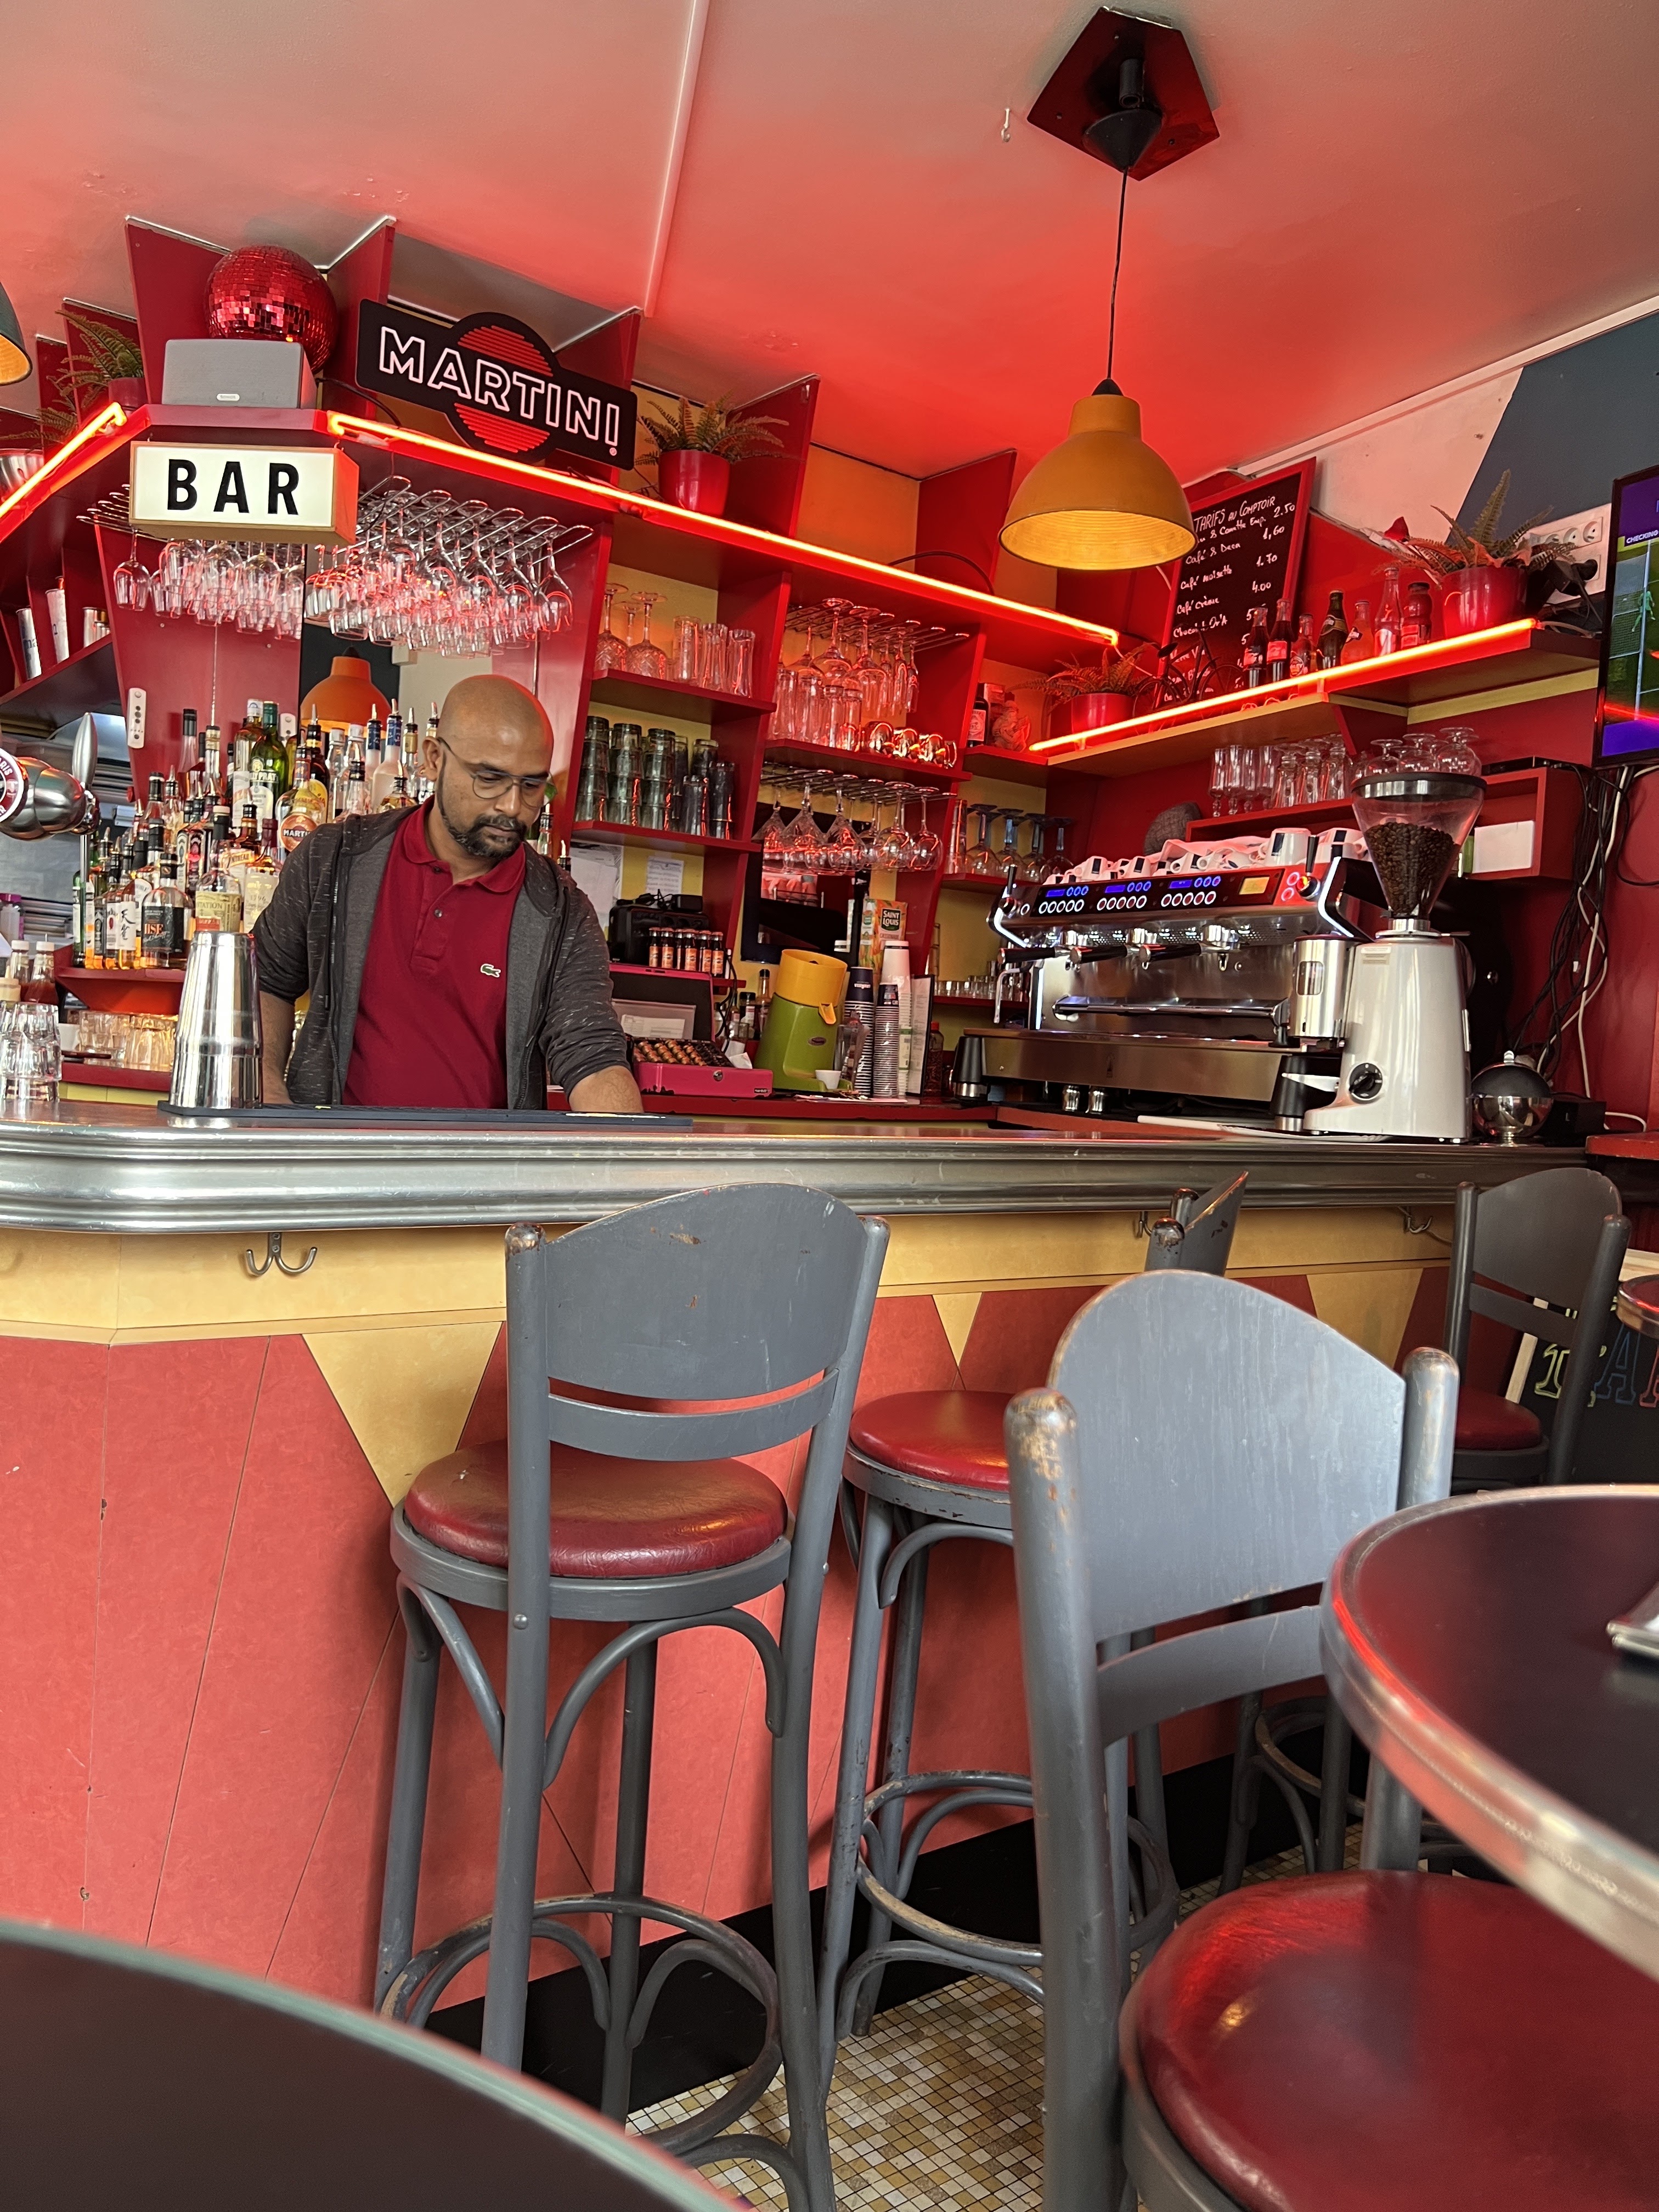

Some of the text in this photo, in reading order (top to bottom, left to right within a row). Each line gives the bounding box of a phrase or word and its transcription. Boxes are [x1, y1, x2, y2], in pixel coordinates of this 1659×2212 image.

[379, 326, 619, 447] MARTINI
[167, 459, 300, 515] BAR
[1273, 503, 1295, 518] 2.50
[1626, 529, 1658, 544] CHECKING
[1185, 549, 1206, 565] Café
[1180, 575, 1200, 591] Café
[1256, 553, 1278, 567] 1.70
[1177, 600, 1194, 616] Café
[1251, 580, 1272, 593] 4.00
[0, 758, 13, 775] RIS
[882, 917, 899, 927] LOUIS
[883, 910, 900, 919] SAINT
